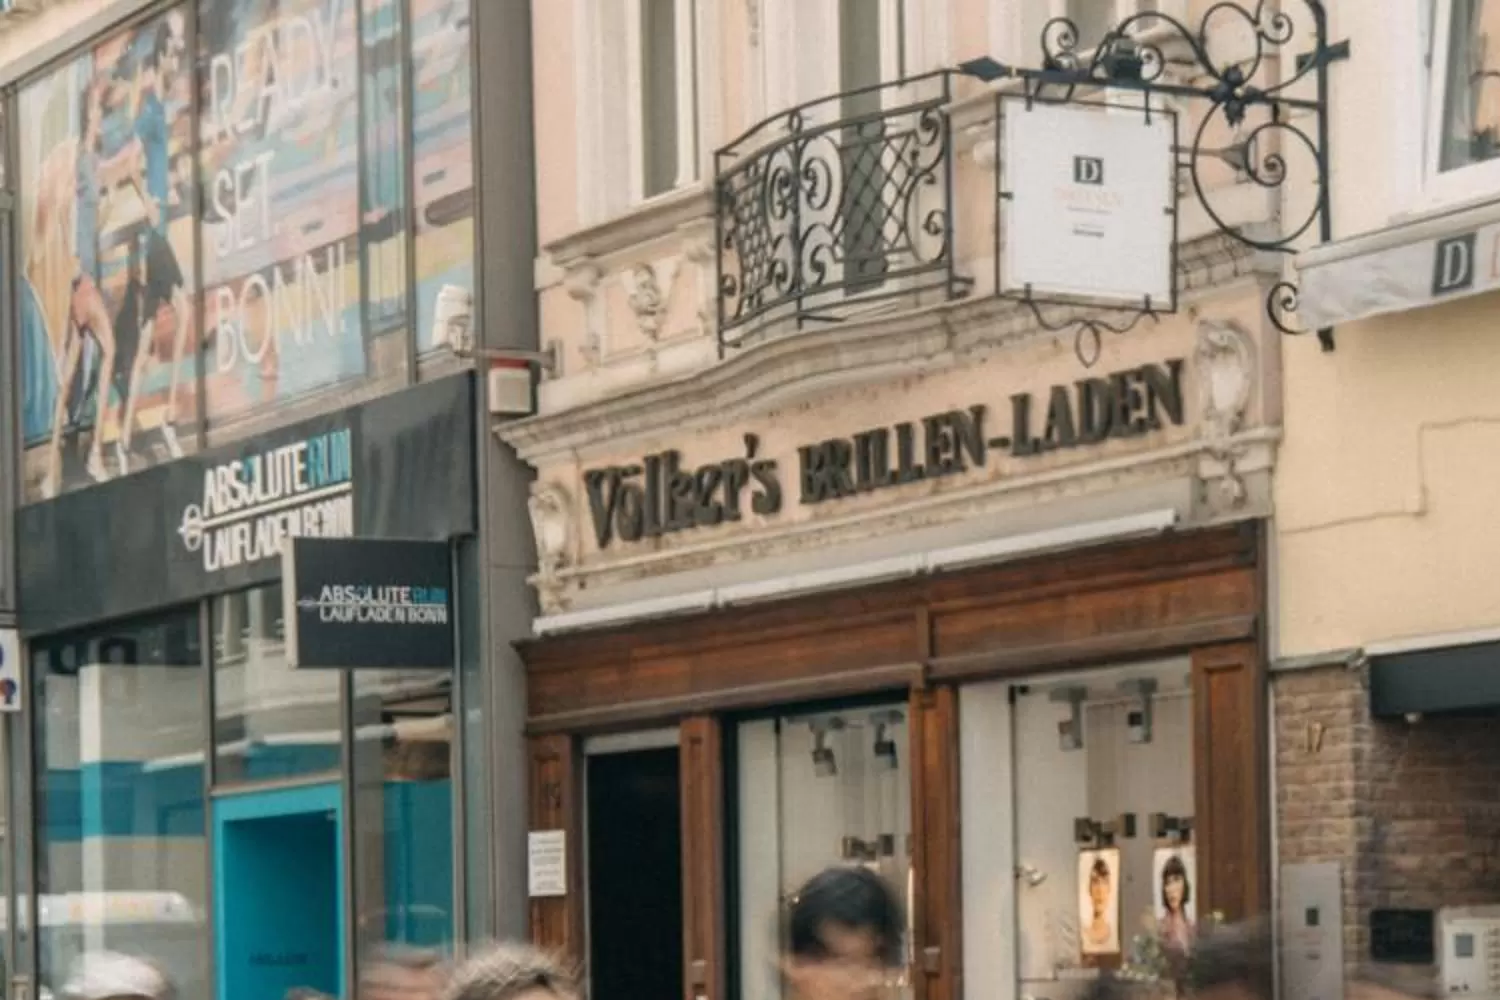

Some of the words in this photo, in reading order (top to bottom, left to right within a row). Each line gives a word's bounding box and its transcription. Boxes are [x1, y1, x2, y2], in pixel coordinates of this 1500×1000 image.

[797, 358, 1184, 504] BRILLEN-LADEN
[319, 605, 405, 624] LAUFLADEN
[408, 606, 448, 625] BONN
